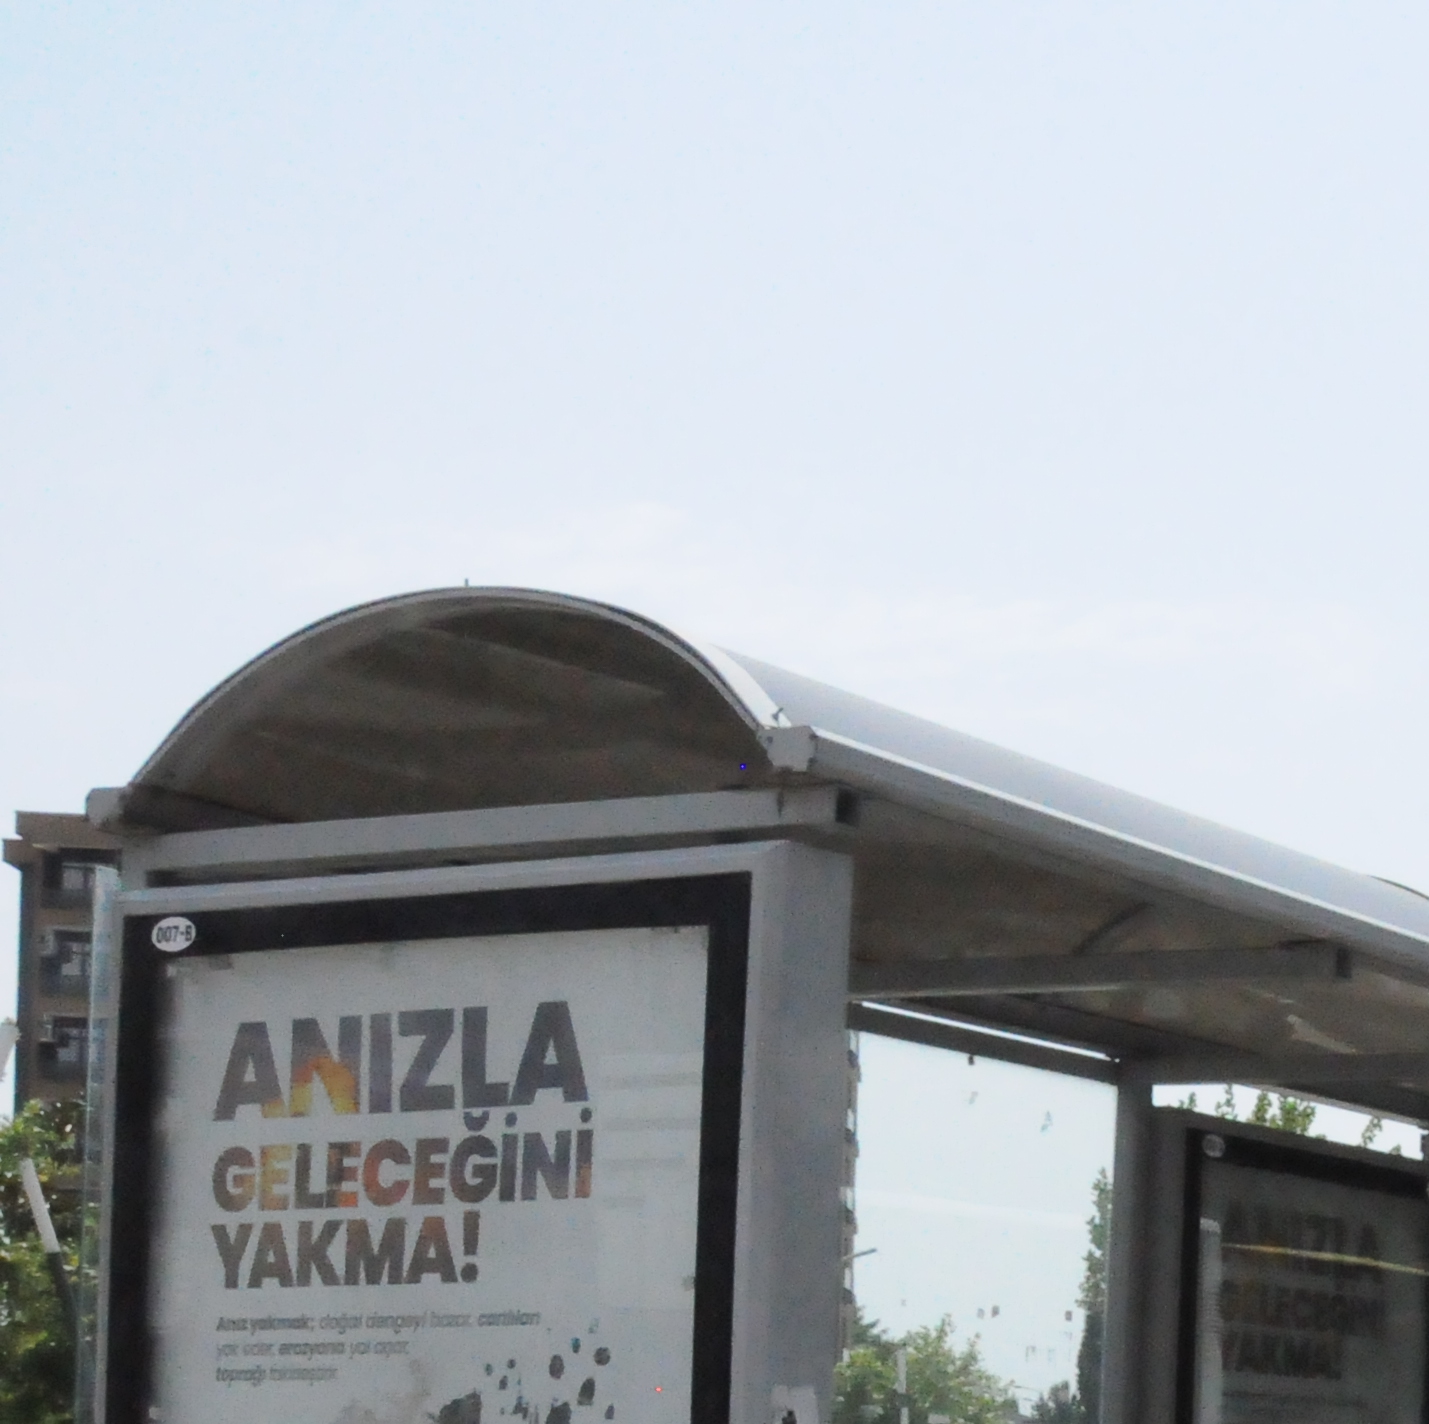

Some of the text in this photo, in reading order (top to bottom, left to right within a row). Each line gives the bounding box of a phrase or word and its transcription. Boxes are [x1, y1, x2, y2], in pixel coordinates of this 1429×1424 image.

[212, 1001, 589, 1121] ANIZLA
[212, 1107, 594, 1213] GELECEĞİNİ
[211, 1210, 481, 1289] YAKMA!
